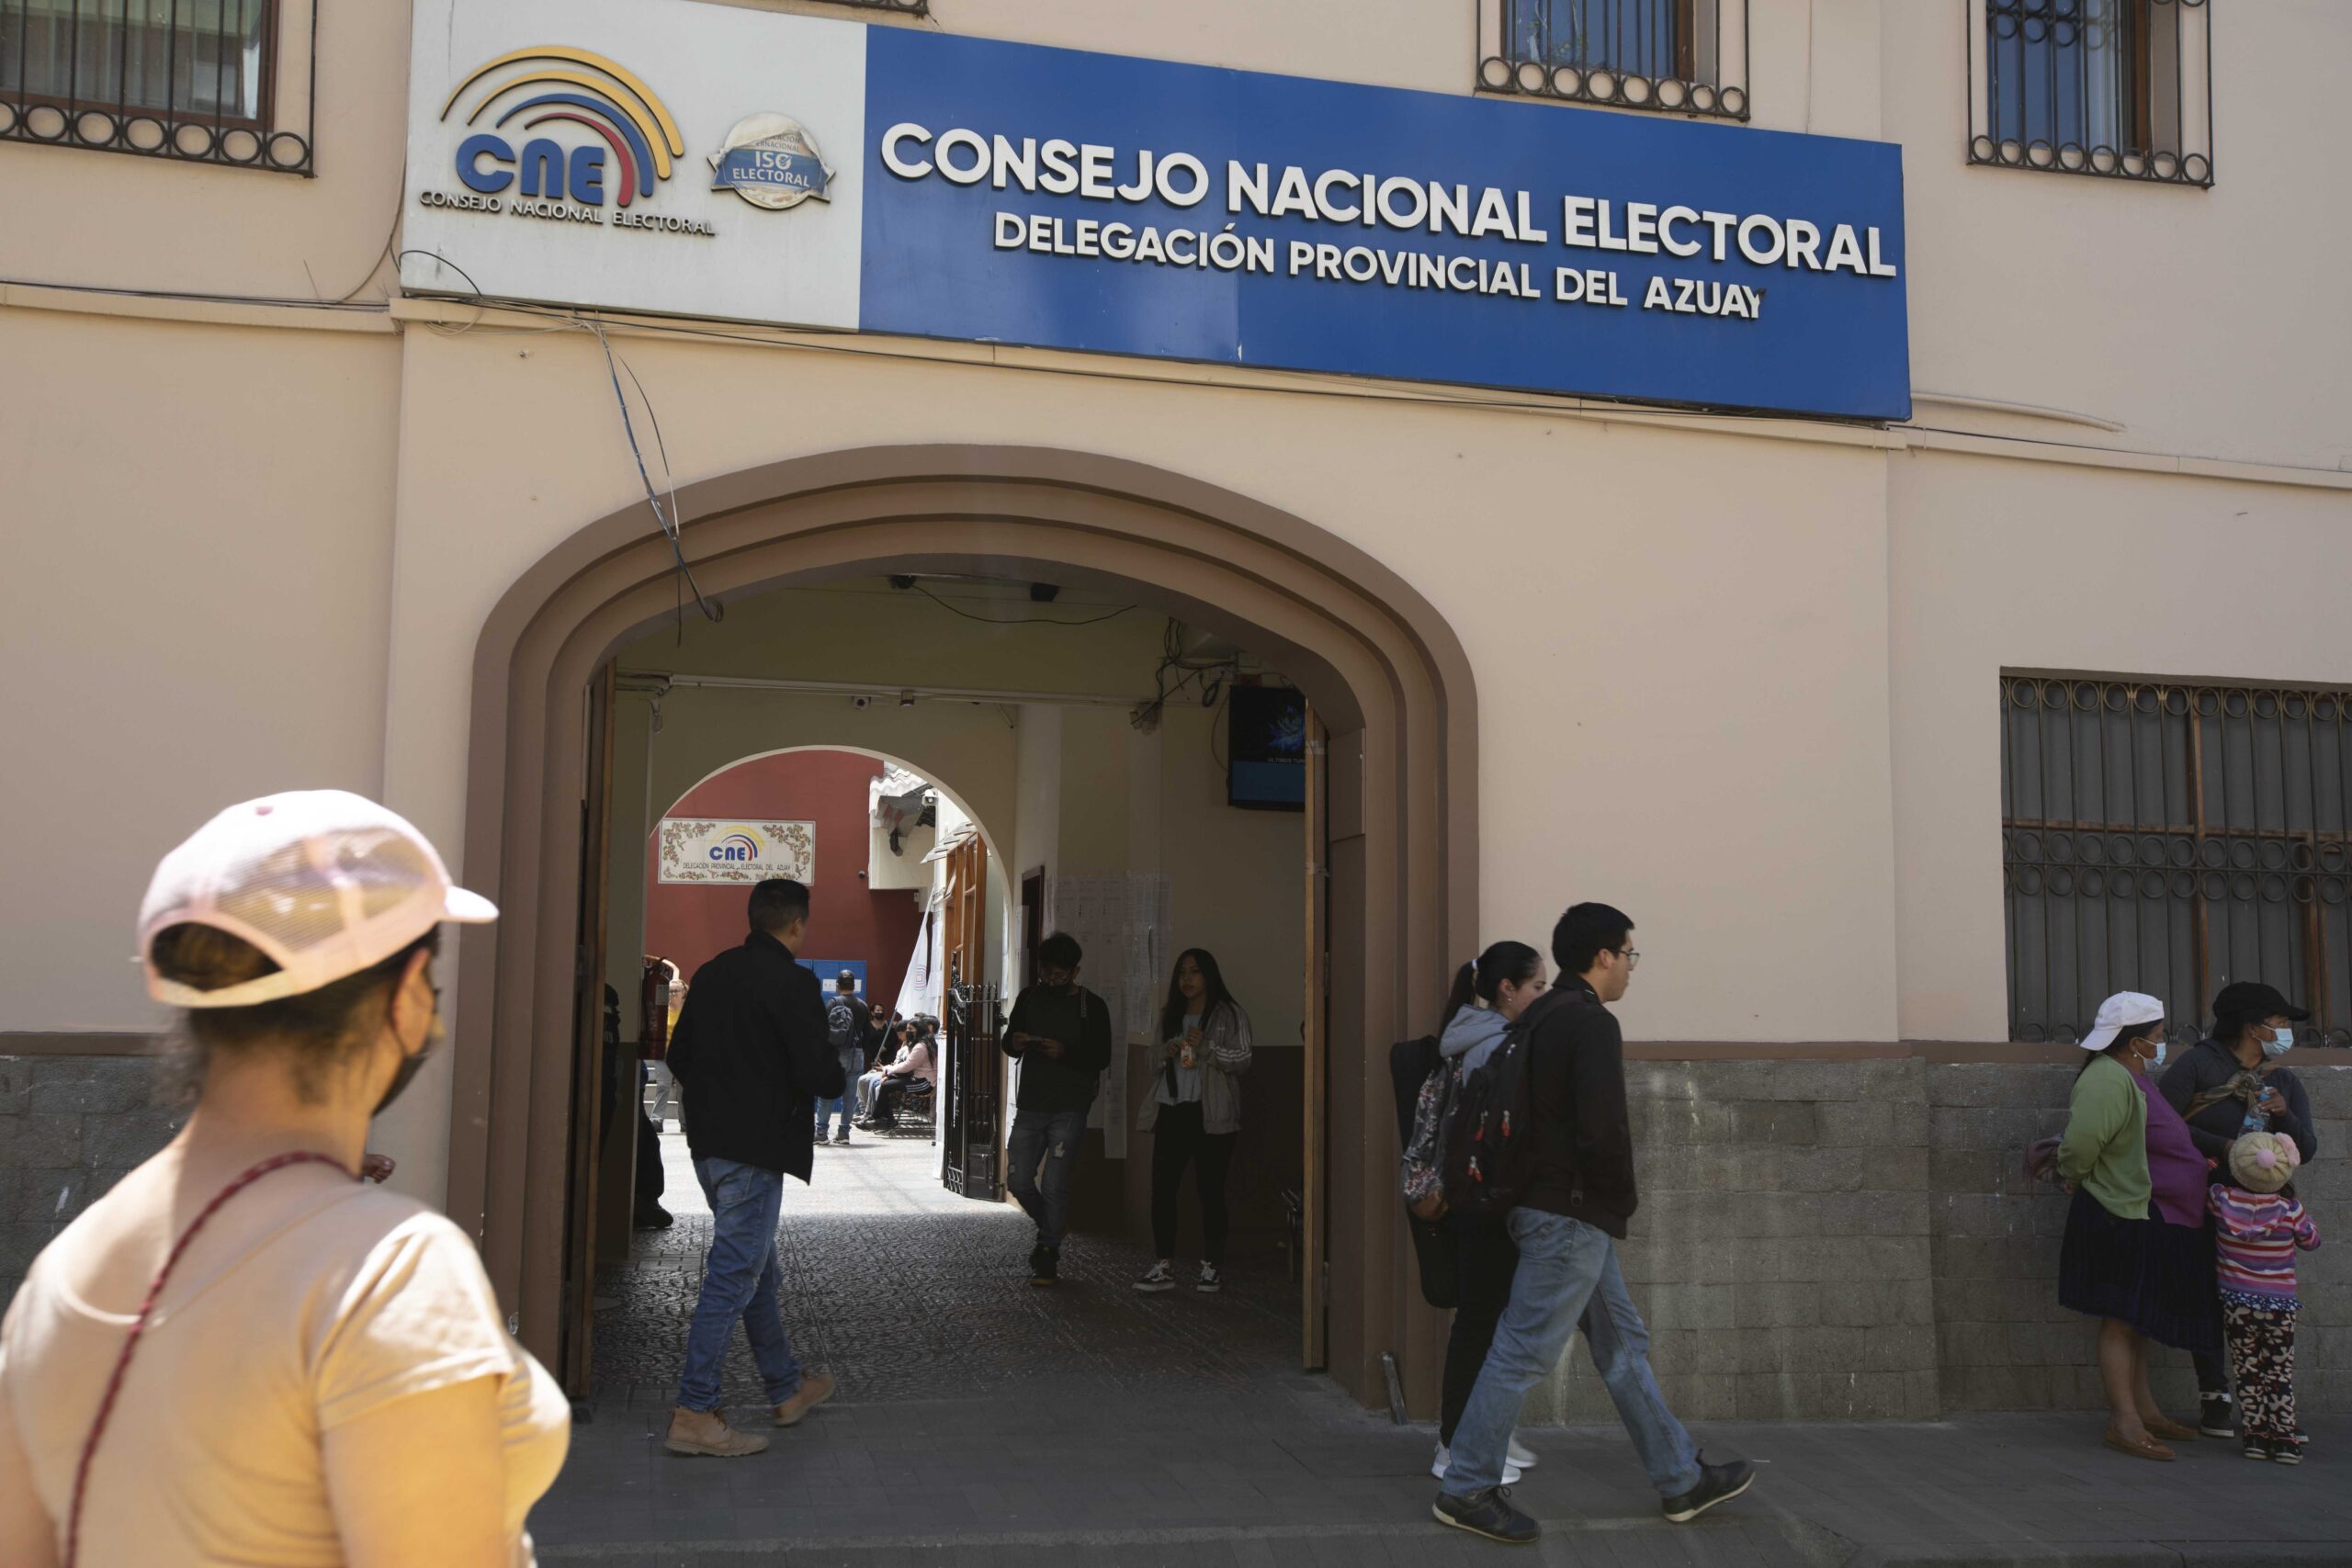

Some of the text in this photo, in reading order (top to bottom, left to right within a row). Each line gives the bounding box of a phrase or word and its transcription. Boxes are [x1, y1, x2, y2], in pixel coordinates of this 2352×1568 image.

[732, 168, 810, 187] ELECTORAL
[755, 151, 792, 170] ISO
[420, 189, 716, 238] CONSEJO NACIONAL ELECTORAL
[881, 122, 1897, 277] CONSEJO NACIONAL ELECTORAL
[993, 211, 1767, 319] DELEGACIÓN PROVINCIAL DEL AZUAY
